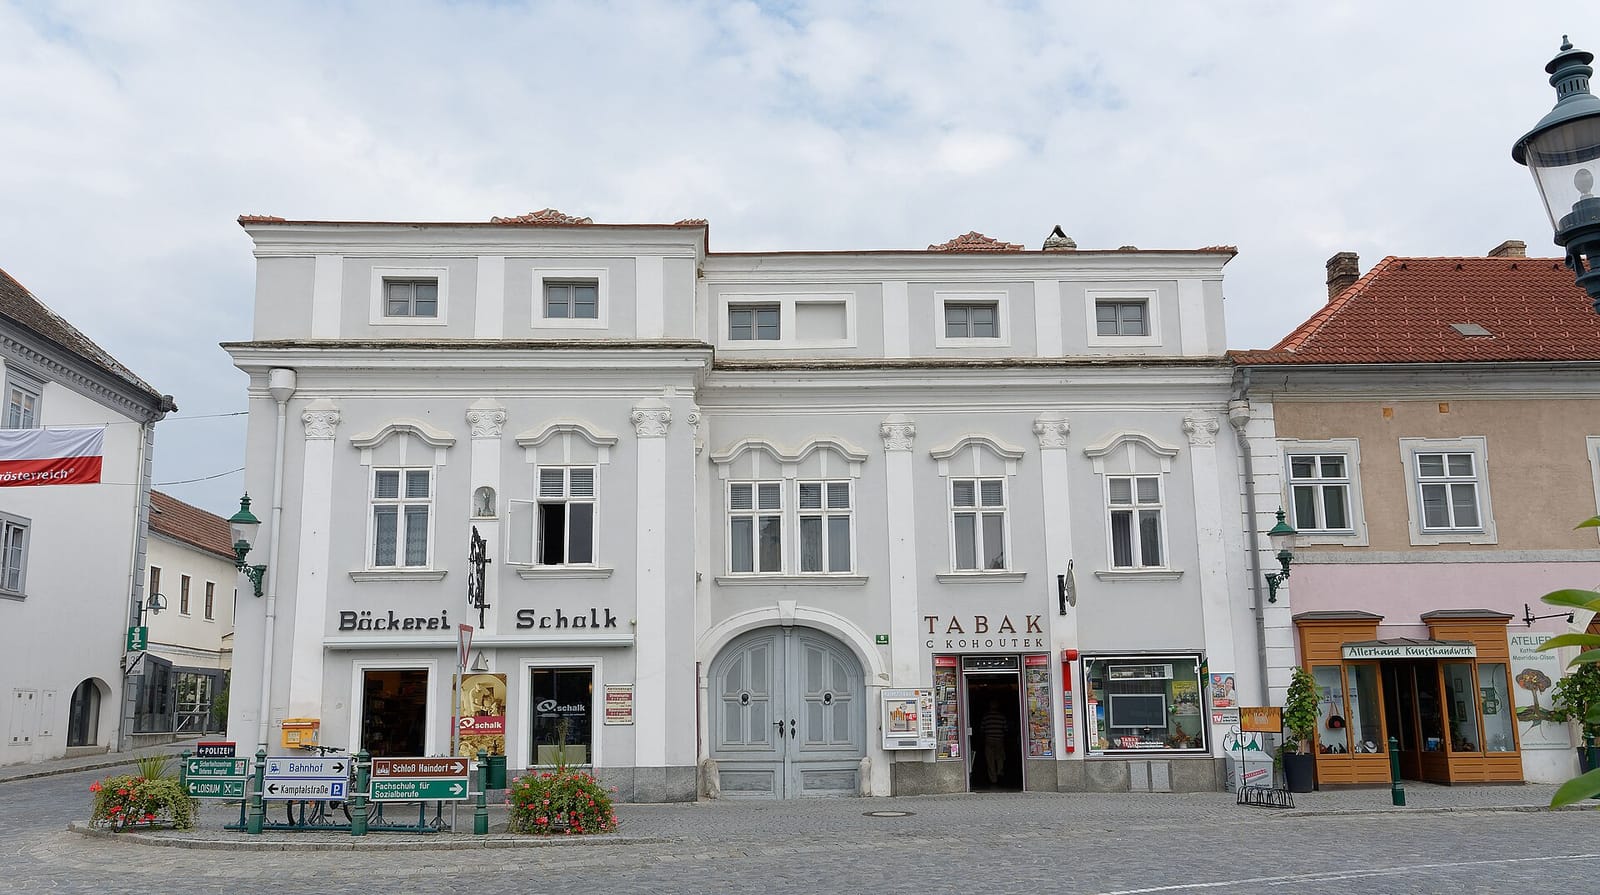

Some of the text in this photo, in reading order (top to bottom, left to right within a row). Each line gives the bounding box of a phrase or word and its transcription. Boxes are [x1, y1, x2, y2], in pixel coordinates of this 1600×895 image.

[339, 608, 616, 631] Bäckerei Schalk
[924, 615, 1043, 634] TABAK
[946, 638, 1043, 649] KOHOUTEK
[1348, 645, 1473, 657] Allerhand Kunsthandwerk
[205, 747, 230, 755] POLIZEI
[289, 763, 323, 773] Bahnhof
[393, 764, 448, 773] Schloß Haindorf
[197, 784, 220, 793] LOISIUM
[280, 784, 329, 796] Kamptalstraße
[420, 782, 430, 790] für
